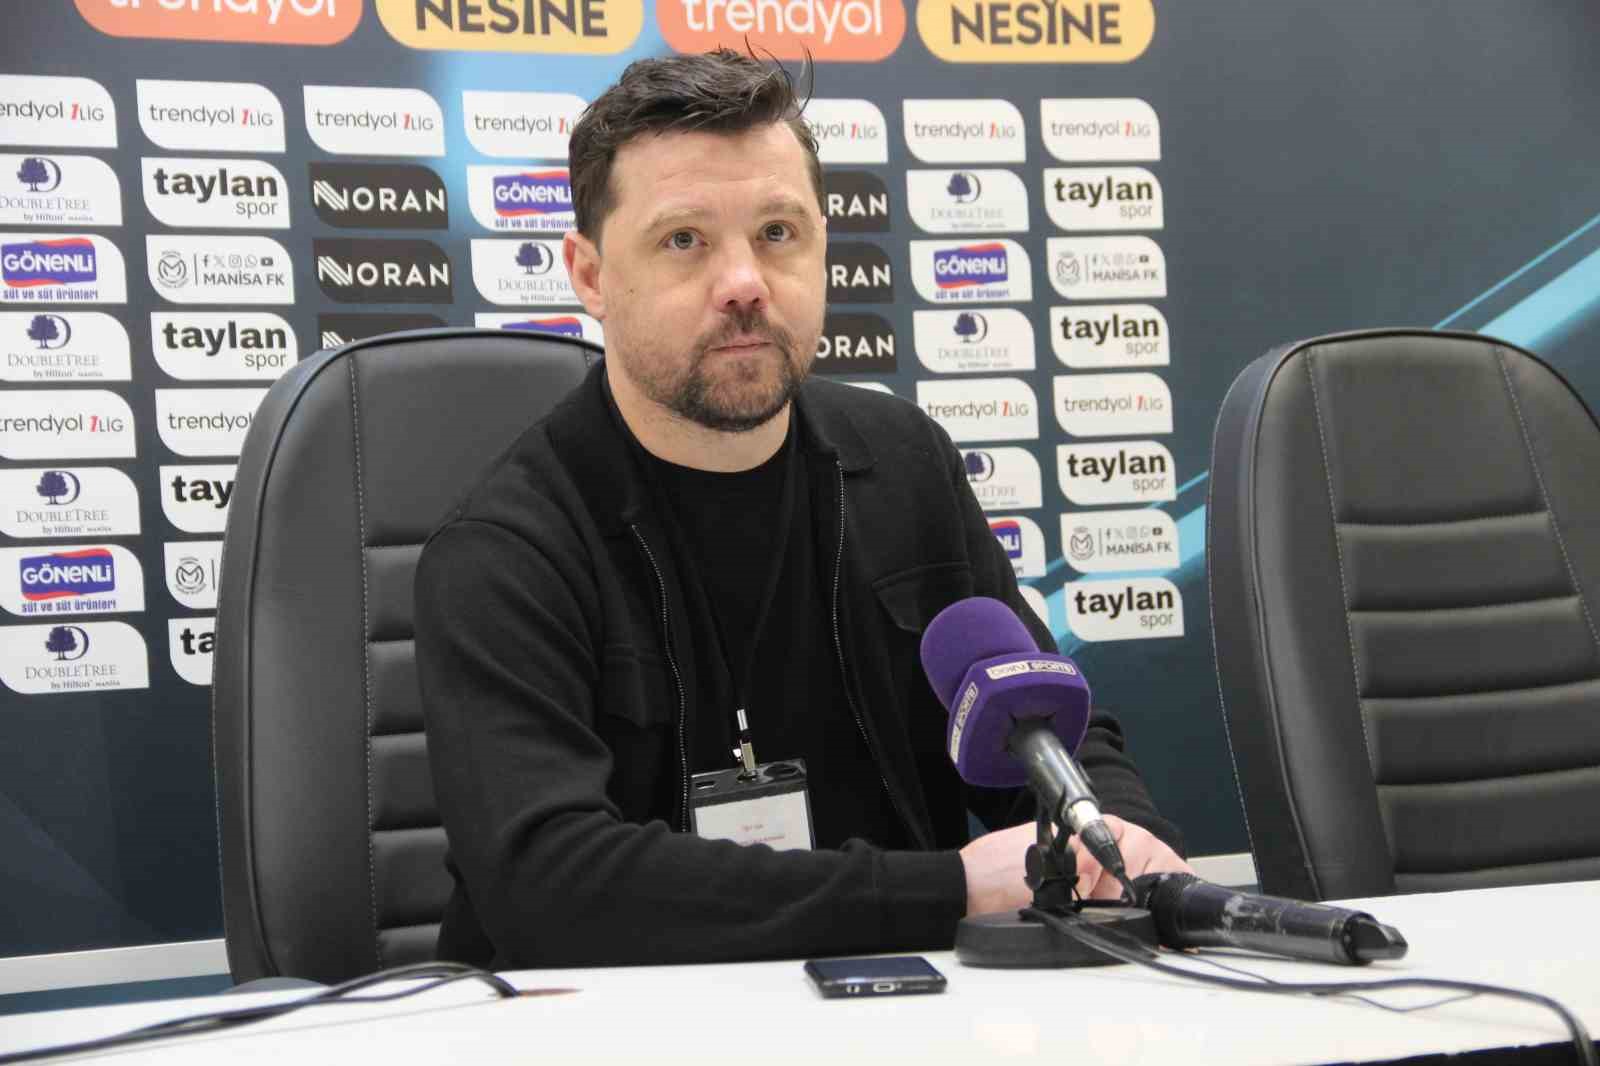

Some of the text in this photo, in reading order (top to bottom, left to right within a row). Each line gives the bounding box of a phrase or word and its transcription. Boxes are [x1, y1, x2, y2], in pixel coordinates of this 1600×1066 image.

[681, 0, 883, 44] trendyol
[0, 99, 64, 121] ndyol
[150, 103, 235, 126] trendyol
[316, 108, 397, 132] trendyol
[474, 113, 552, 136] trendyol
[914, 121, 984, 141] trendyol
[1051, 120, 1120, 139] trendyol
[153, 168, 279, 203] taylan
[313, 180, 446, 212] NORAN
[1054, 177, 1153, 208] taylan
[235, 202, 279, 219] spor
[828, 193, 887, 216] RAN
[1119, 203, 1152, 220] spor
[266, 273, 285, 286] FK
[318, 256, 449, 286] NORAN
[832, 264, 891, 287] RAN
[162, 321, 287, 356] taylan
[1060, 314, 1160, 345] taylan
[816, 335, 894, 358] ORAN
[1125, 340, 1160, 357] spor
[244, 352, 287, 371] spor
[928, 400, 997, 420] trendyol
[1064, 396, 1132, 413] trendyol
[1067, 450, 1167, 482] taylan
[171, 475, 236, 509] tay
[1133, 477, 1166, 493] spor
[1157, 541, 1173, 553] FK
[1074, 586, 1174, 618] taylan
[1140, 613, 1173, 629] spor
